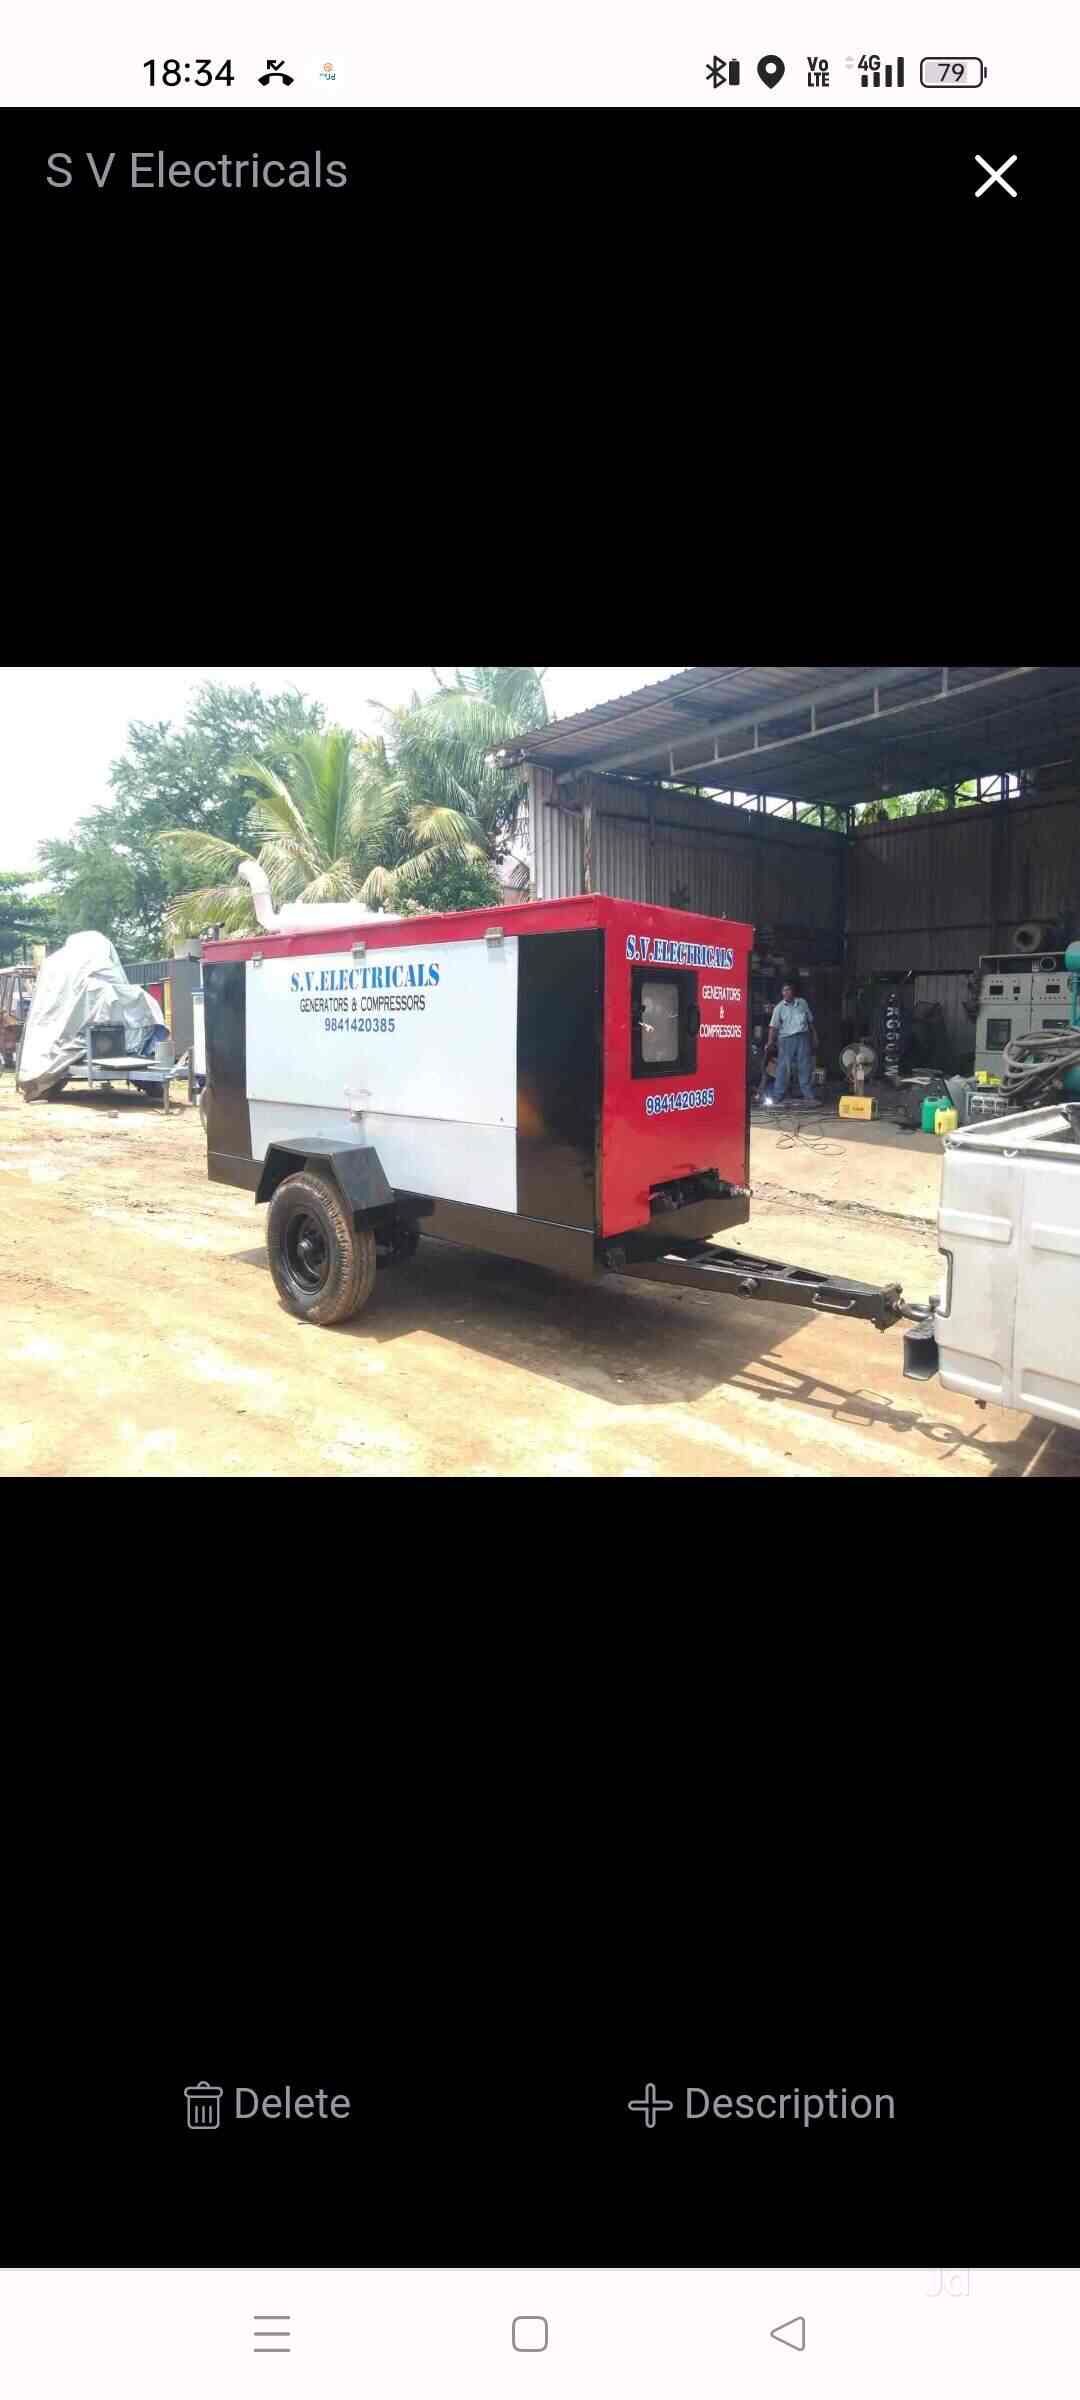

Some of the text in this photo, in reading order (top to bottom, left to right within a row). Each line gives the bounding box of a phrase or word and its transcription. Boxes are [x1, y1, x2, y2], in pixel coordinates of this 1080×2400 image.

[807, 56, 829, 71] Vo
[857, 54, 881, 72] 4G
[143, 58, 235, 87] 18:34
[807, 72, 830, 88] LTE
[937, 63, 965, 82] 79
[46, 149, 348, 188] S V Electricals
[290, 962, 440, 992] S.V.ELECTRICALS
[702, 985, 741, 1001] GENERATORS
[300, 995, 426, 1012] GENERATORS & COMPRESSORS
[324, 1017, 396, 1032] 9841420385
[699, 1023, 742, 1038] COMPRESSORS
[645, 1087, 715, 1116] 9841420385
[235, 2085, 351, 2119] Delete
[686, 2085, 895, 2128] Description
